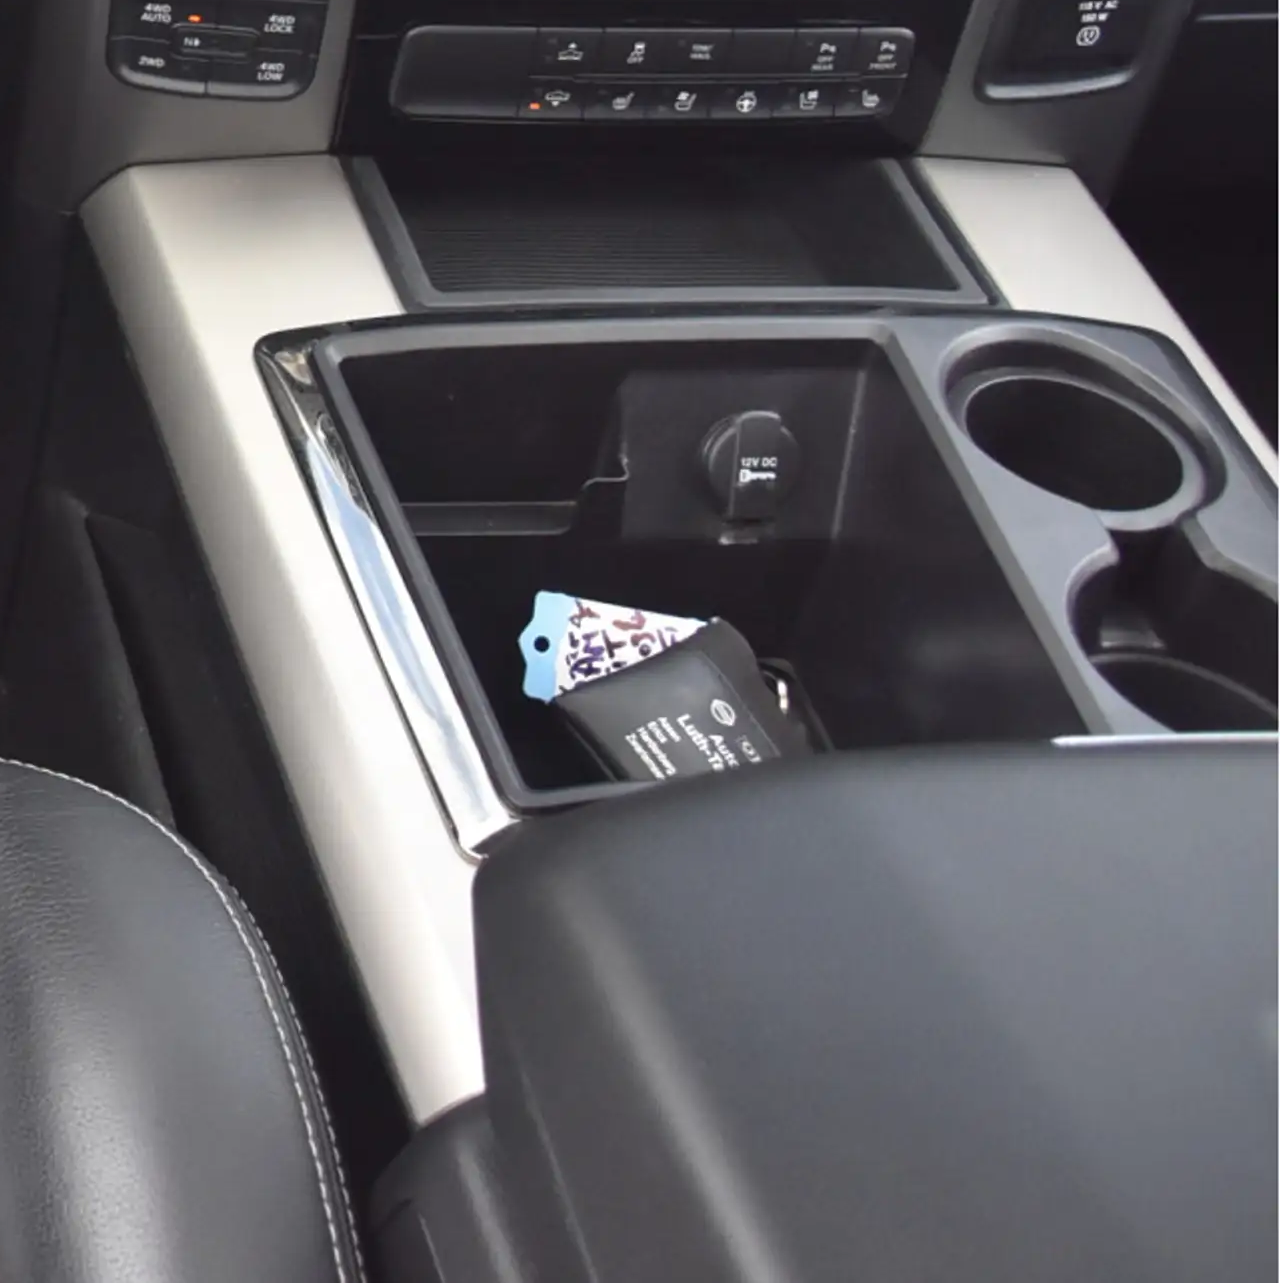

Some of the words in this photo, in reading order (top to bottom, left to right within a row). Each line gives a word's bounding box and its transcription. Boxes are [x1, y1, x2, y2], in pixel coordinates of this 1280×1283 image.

[144, 3, 172, 13] 4WD
[140, 13, 172, 23] AUTO
[268, 14, 296, 24] 4WD
[263, 23, 294, 34] LOCK
[138, 55, 165, 68] 2WD
[258, 62, 285, 72] 4WD
[256, 72, 283, 82] LOW
[741, 457, 759, 467] 12V
[762, 457, 778, 467] DC
